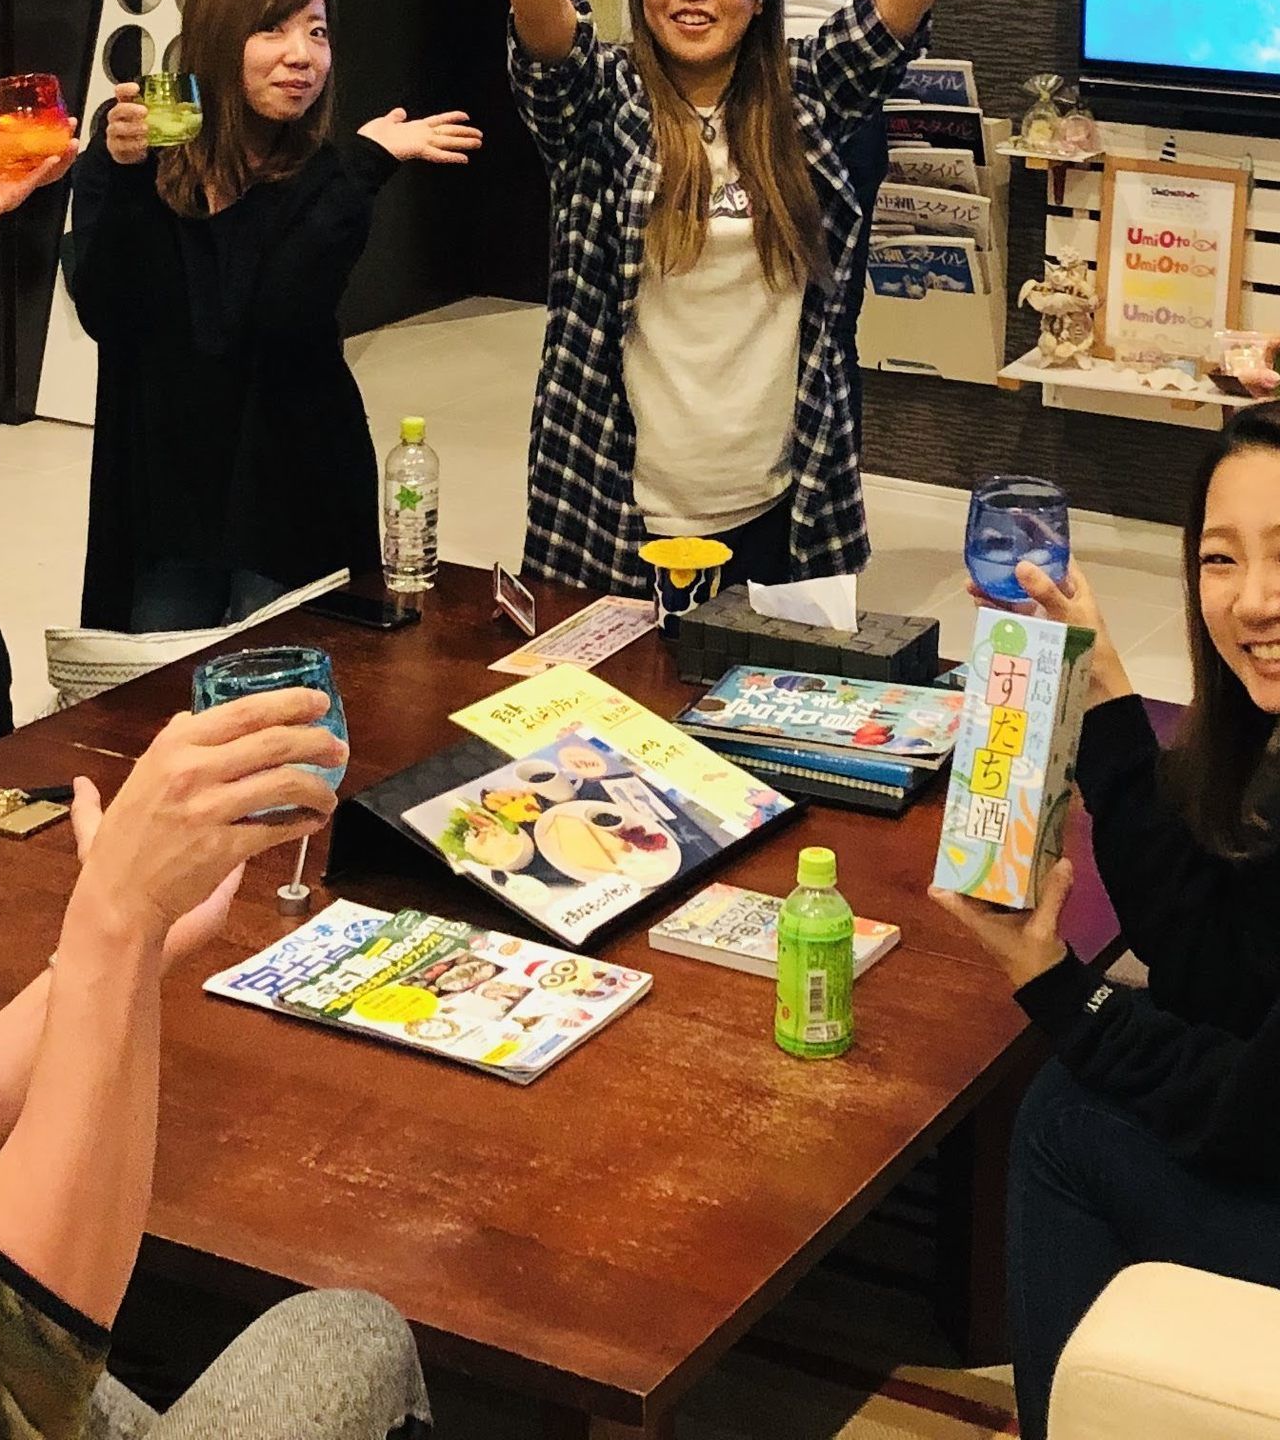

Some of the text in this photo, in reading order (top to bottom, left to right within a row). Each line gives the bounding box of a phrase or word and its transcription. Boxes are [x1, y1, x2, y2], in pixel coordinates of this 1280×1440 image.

[1127, 226, 1191, 249] UmiOto
[1125, 252, 1190, 274] UmiOto
[1123, 303, 1186, 325] UmiOto
